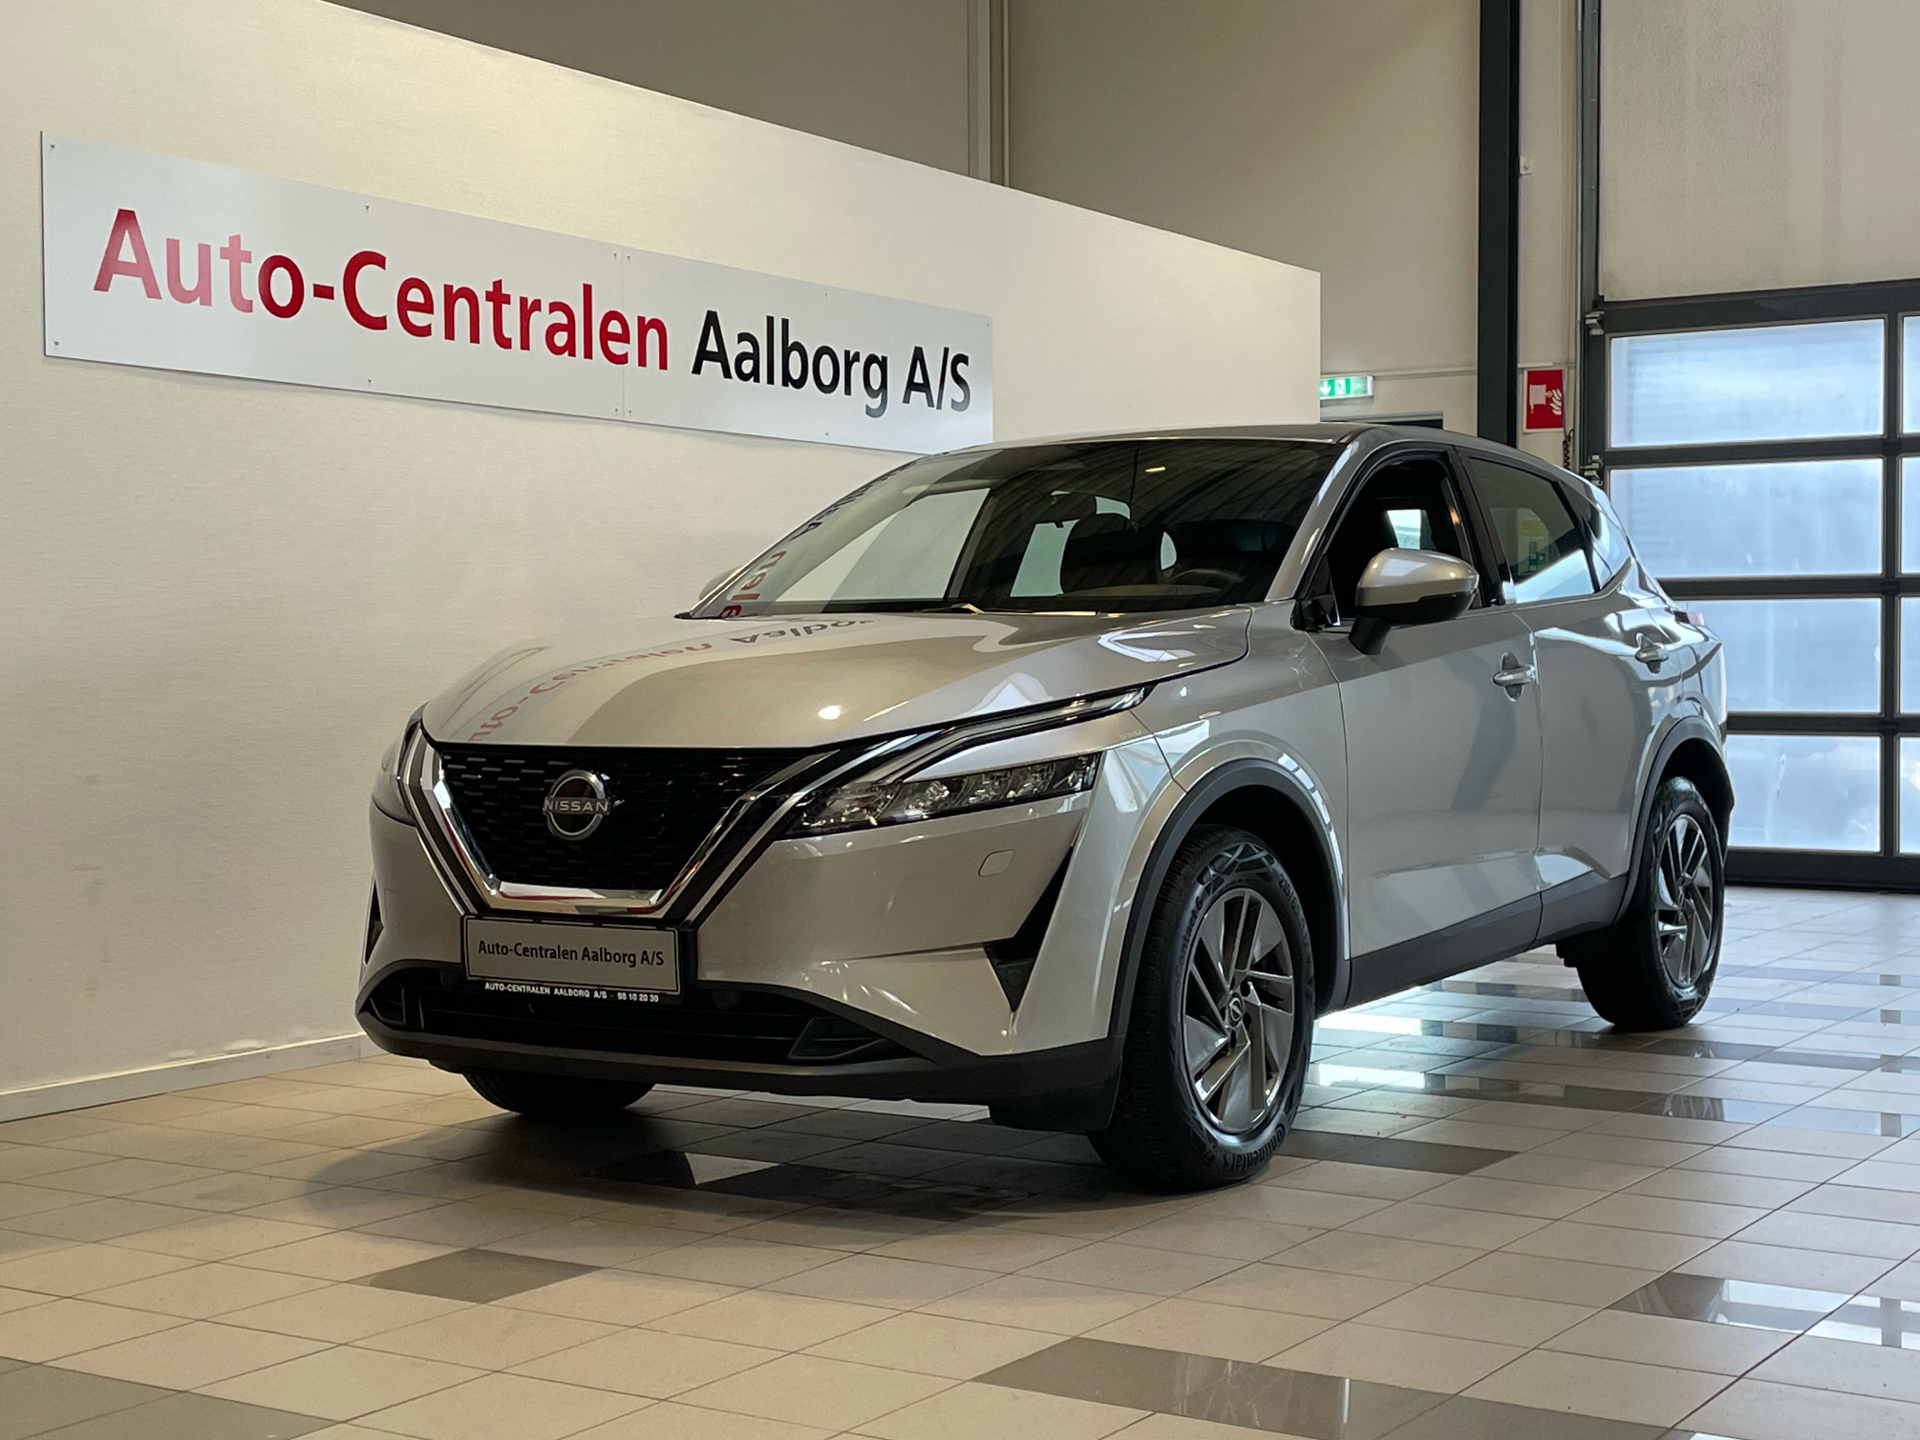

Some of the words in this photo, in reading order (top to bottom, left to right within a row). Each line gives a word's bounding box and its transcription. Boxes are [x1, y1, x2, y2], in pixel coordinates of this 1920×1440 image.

[93, 208, 668, 371] Auto-Centralen
[691, 309, 889, 418] Aalborg
[902, 346, 971, 412] A/S
[544, 800, 609, 812] NISSAN
[478, 940, 578, 961] Auto-Centralen
[581, 947, 637, 968] Aalborg
[640, 950, 664, 966] A/S
[484, 982, 551, 995] AUTO-CENTRALEN
[554, 987, 590, 998] AALBORG
[593, 990, 608, 999] A/S
